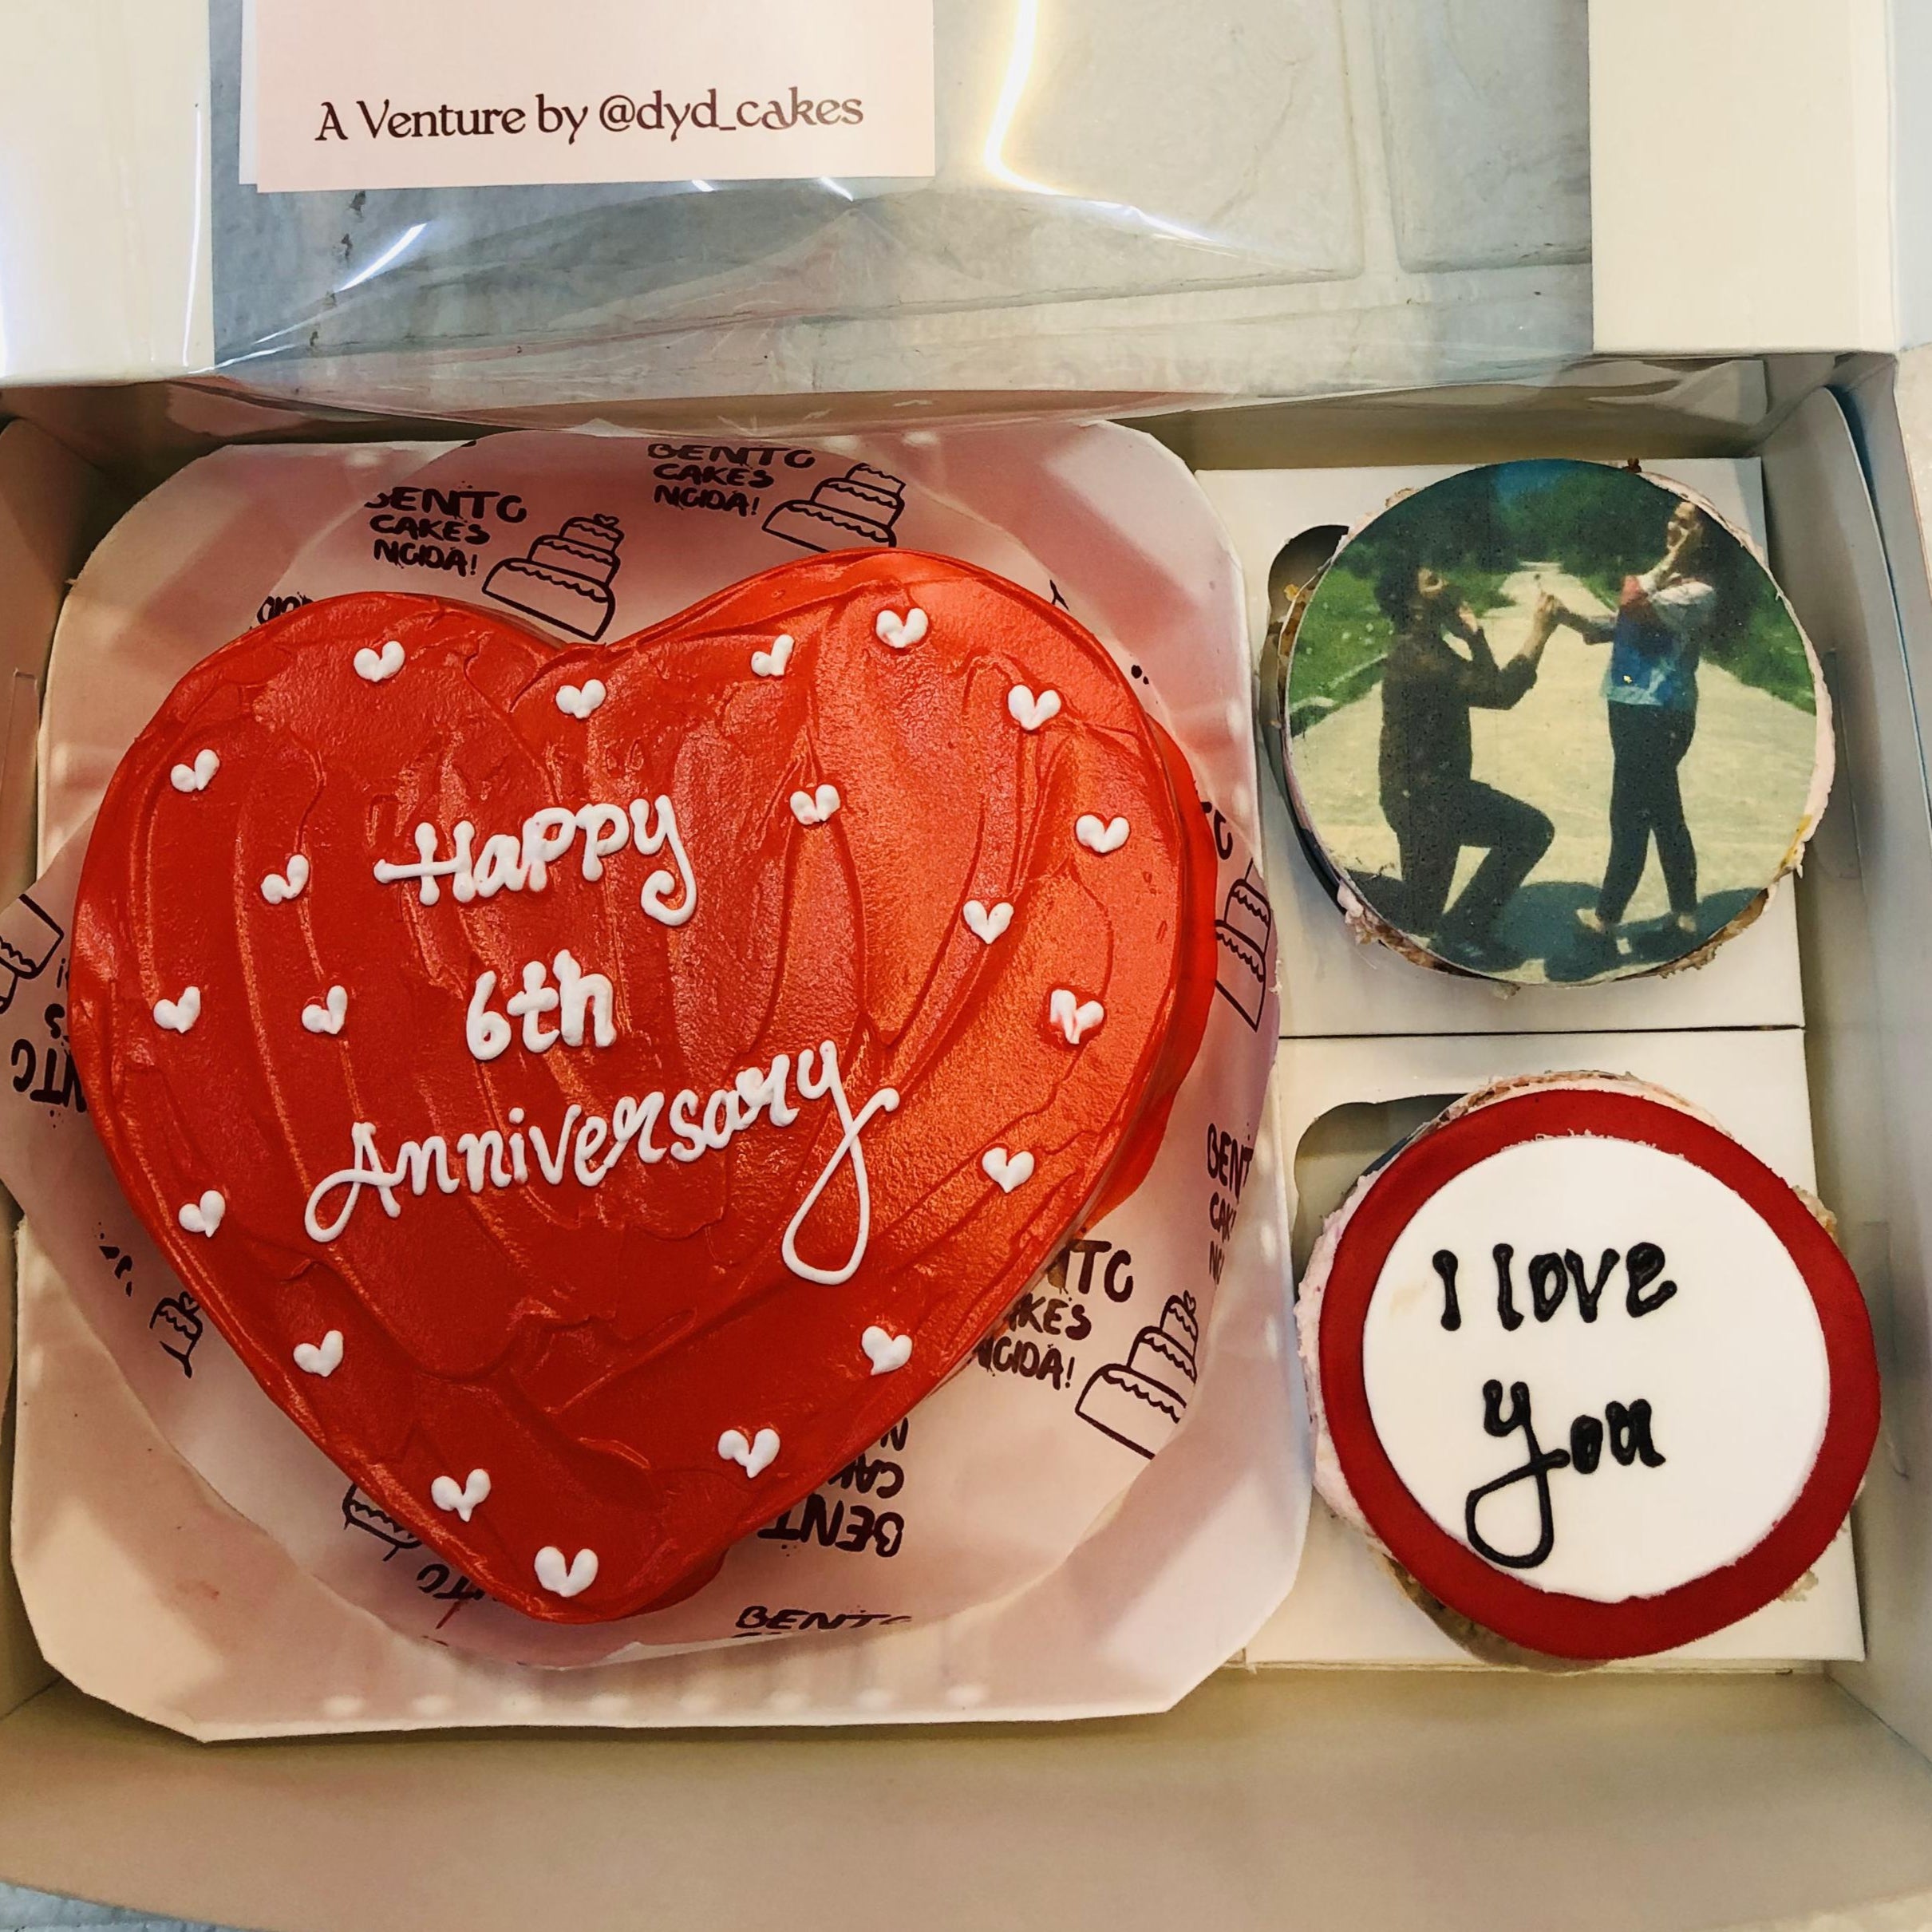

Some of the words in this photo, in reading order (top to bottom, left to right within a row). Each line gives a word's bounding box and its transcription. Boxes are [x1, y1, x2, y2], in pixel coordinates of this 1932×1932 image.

[314, 102, 348, 141] A
[356, 99, 527, 139] Venture
[535, 93, 589, 144] by
[599, 87, 863, 141] @dyd_cakes
[653, 463, 775, 488] CAKES
[369, 514, 491, 545] CAKES
[374, 795, 697, 925] Happy
[467, 950, 616, 1061] 6th
[305, 1041, 899, 1284] Anniversary
[1432, 1248, 1462, 1332] I
[1492, 1241, 1677, 1332] love
[757, 1493, 905, 1558] BENT
